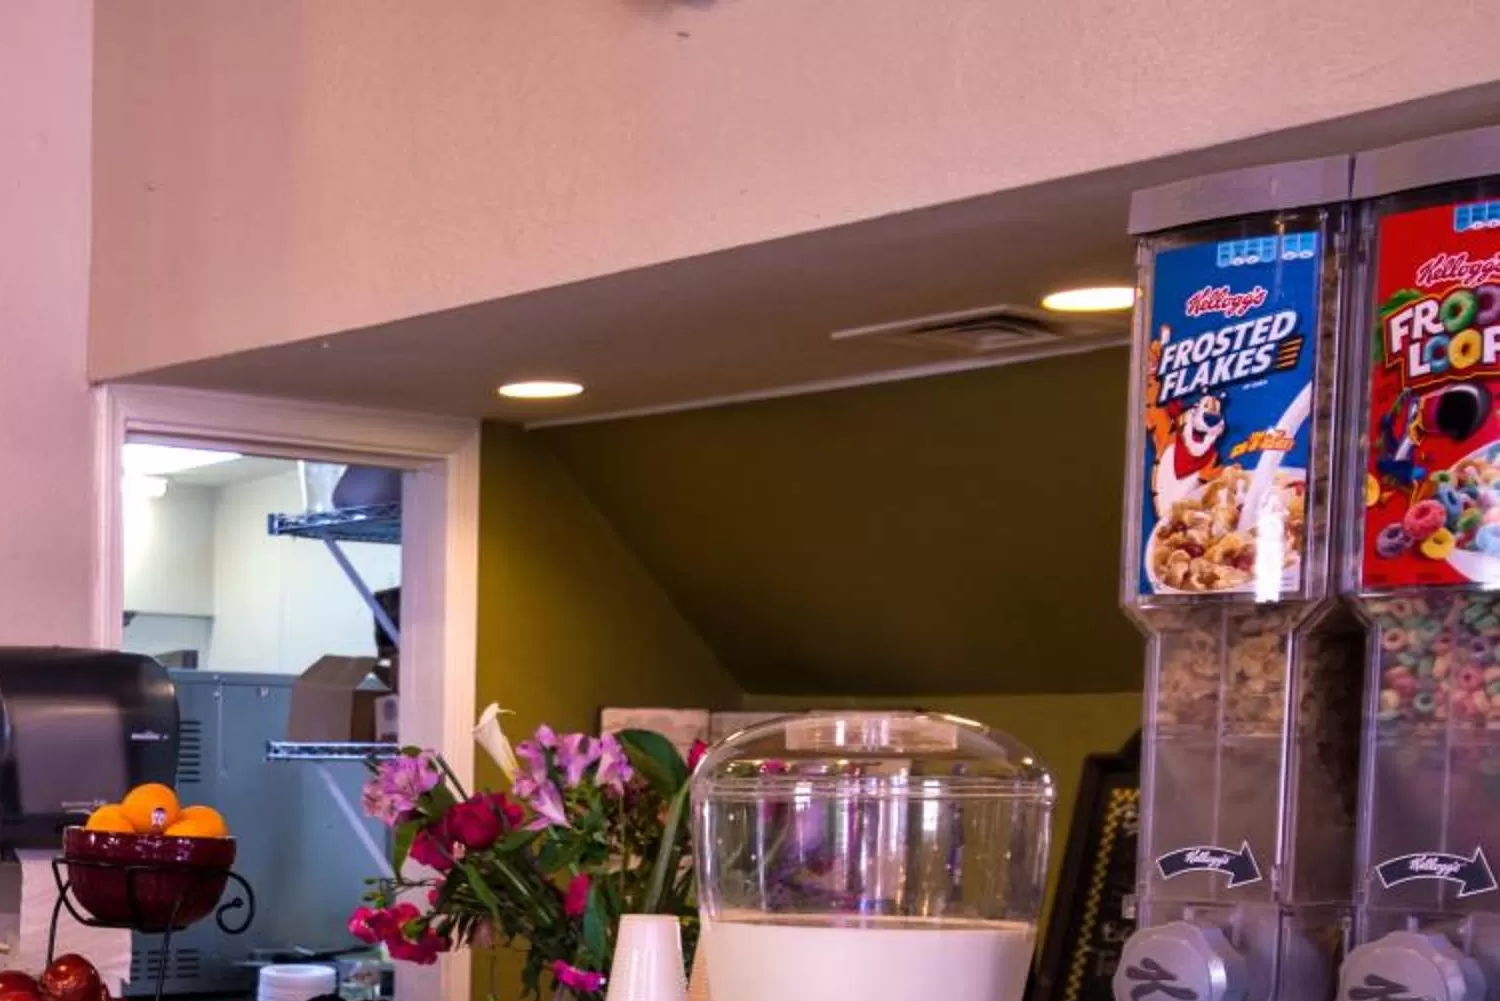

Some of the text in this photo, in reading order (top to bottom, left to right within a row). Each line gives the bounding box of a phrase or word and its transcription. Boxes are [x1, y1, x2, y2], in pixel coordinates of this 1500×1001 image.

[1185, 285, 1268, 318] Kellogg's
[1389, 285, 1500, 353] FROO
[1159, 310, 1297, 376] FROSTED
[1159, 343, 1276, 402] FLAKES
[1409, 326, 1500, 377] LOOP
